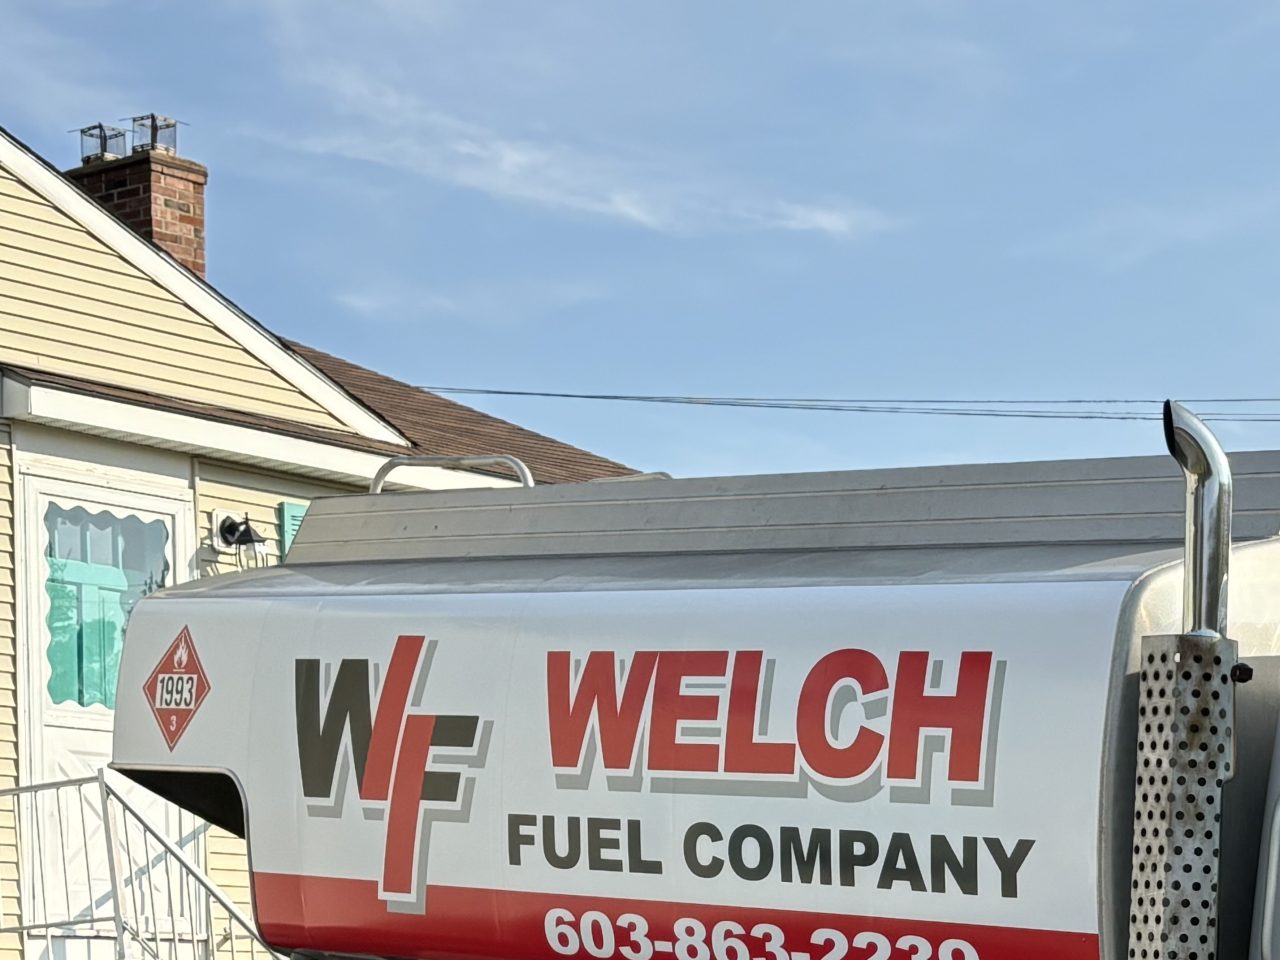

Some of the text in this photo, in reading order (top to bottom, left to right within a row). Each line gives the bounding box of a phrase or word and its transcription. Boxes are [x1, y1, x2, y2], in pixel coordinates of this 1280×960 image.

[159, 675, 195, 707] 1993
[546, 647, 994, 784] WELCH
[169, 715, 177, 731] 3
[507, 813, 1037, 899] FUEL COMPANY
